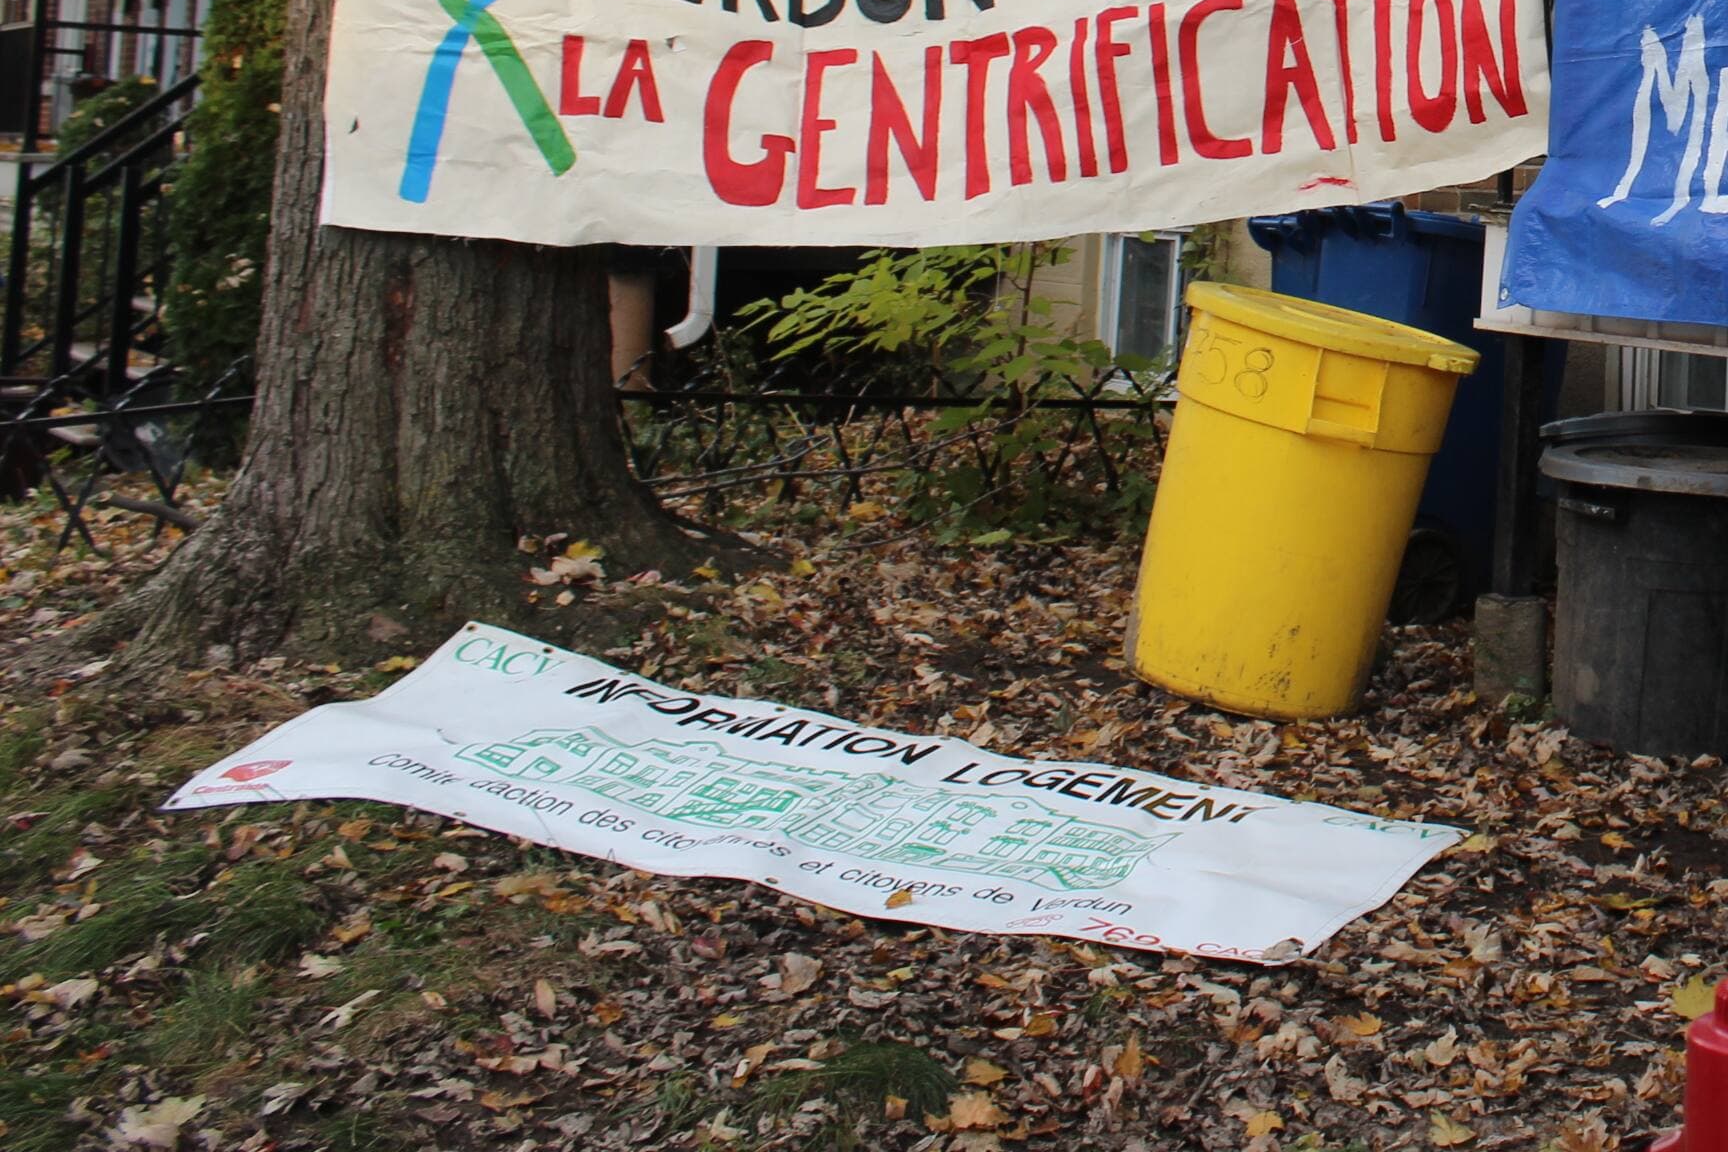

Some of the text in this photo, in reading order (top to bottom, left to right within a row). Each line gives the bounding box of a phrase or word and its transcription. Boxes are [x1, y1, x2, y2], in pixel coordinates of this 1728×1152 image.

[559, 35, 664, 123] LA
[563, 677, 1276, 825] INFORMATION LOGEMENT
[578, 808, 637, 833] des
[799, 859, 835, 875] et
[840, 867, 965, 899] citoyens
[972, 886, 1015, 905] de
